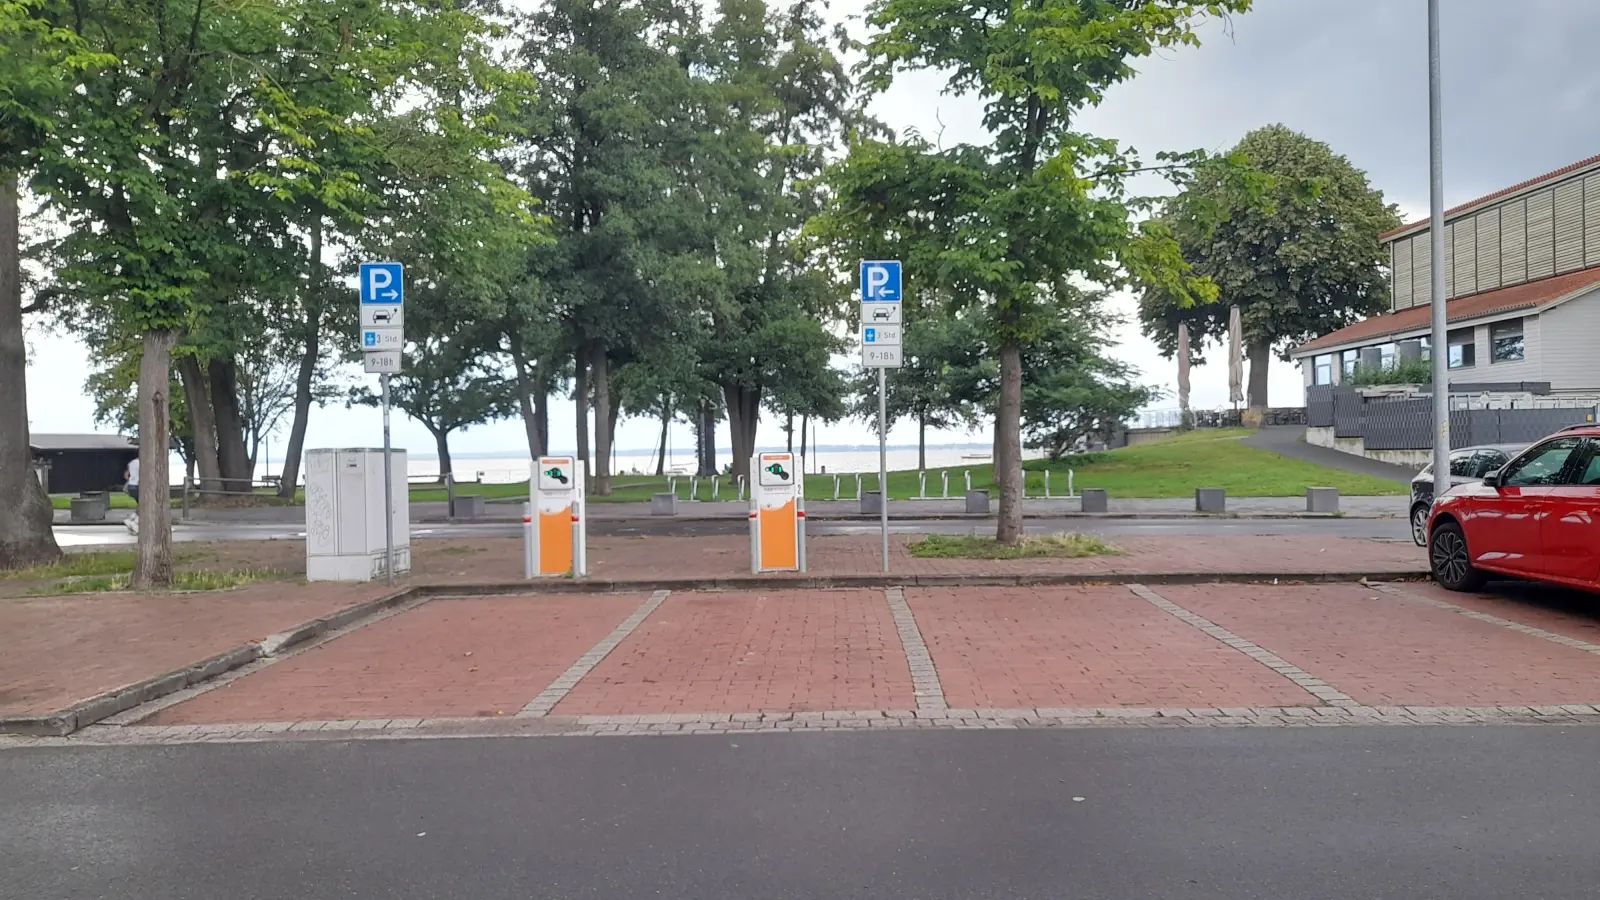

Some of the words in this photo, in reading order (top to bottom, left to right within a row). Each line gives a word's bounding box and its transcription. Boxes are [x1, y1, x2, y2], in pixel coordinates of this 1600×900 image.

[369, 268, 392, 300] P
[867, 267, 889, 298] P
[377, 334, 381, 343] 3
[883, 331, 896, 339] Std
[869, 351, 895, 360] 9-18h
[371, 357, 394, 367] 9-18h
